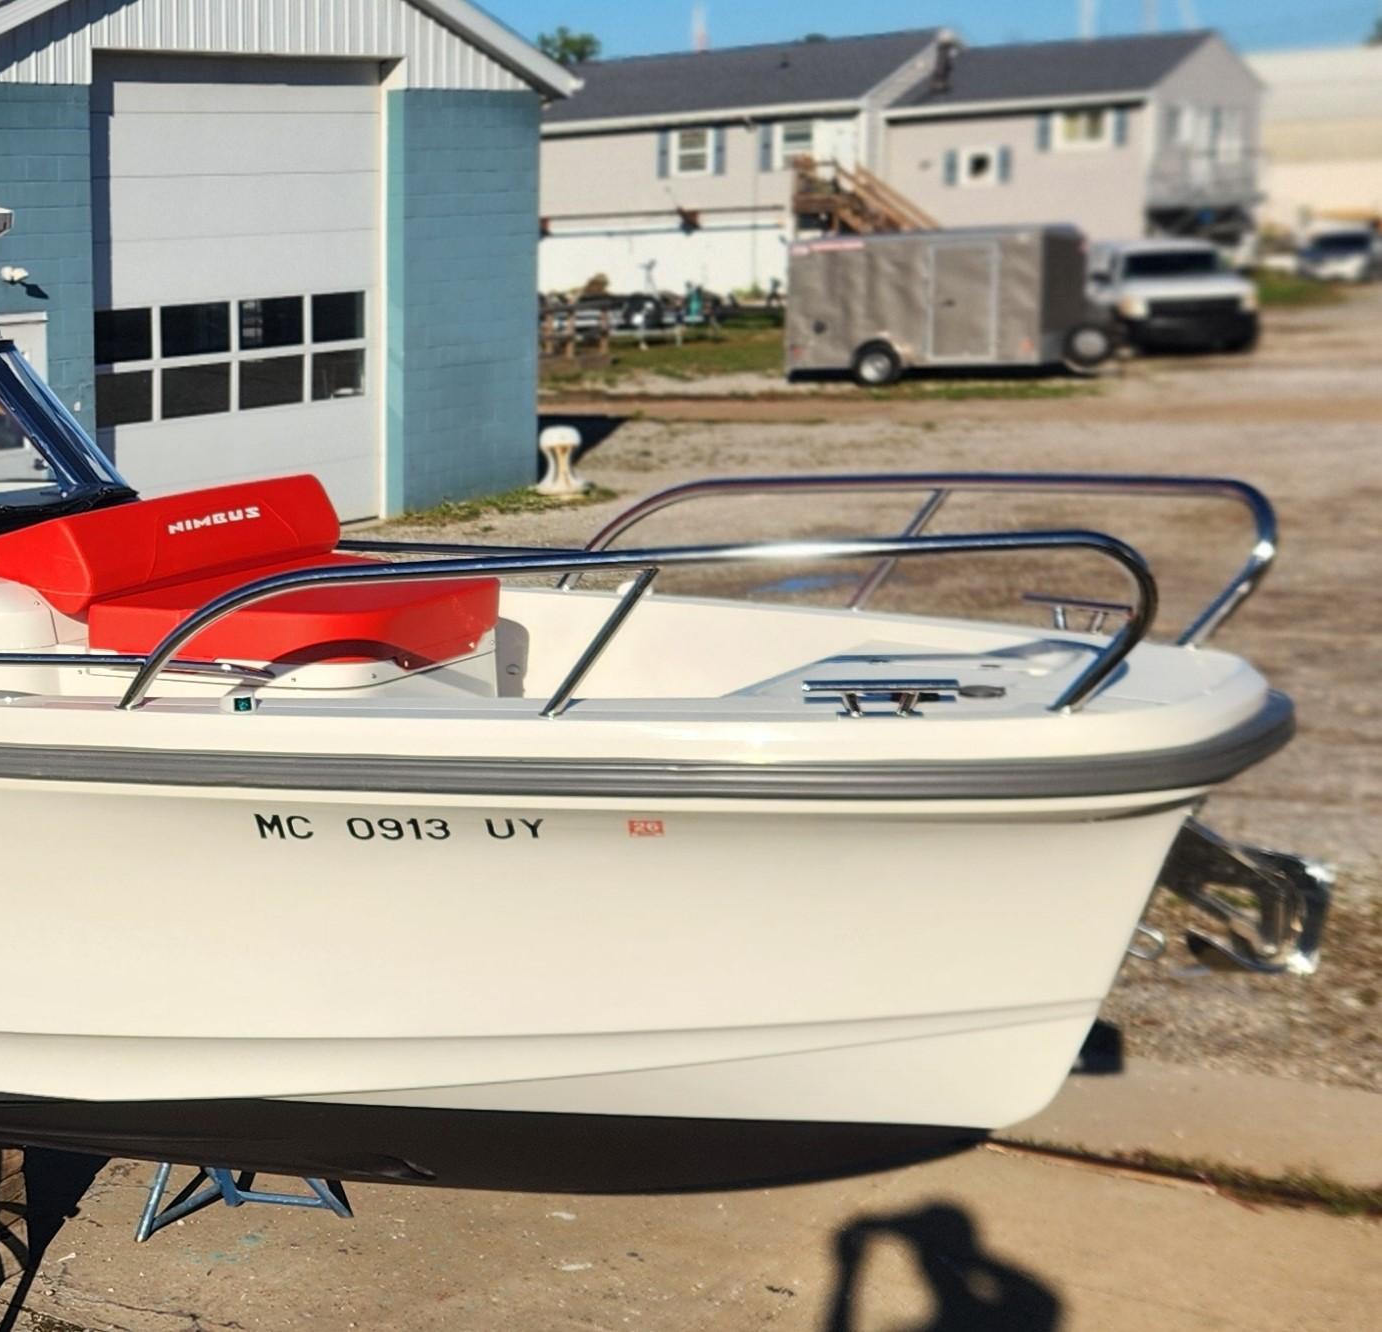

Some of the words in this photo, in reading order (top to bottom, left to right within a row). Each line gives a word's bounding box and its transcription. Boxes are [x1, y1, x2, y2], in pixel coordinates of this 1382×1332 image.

[168, 507, 261, 535] NIMBUS
[254, 813, 314, 840] MC
[346, 817, 451, 841] 0913
[485, 818, 544, 840] UY
